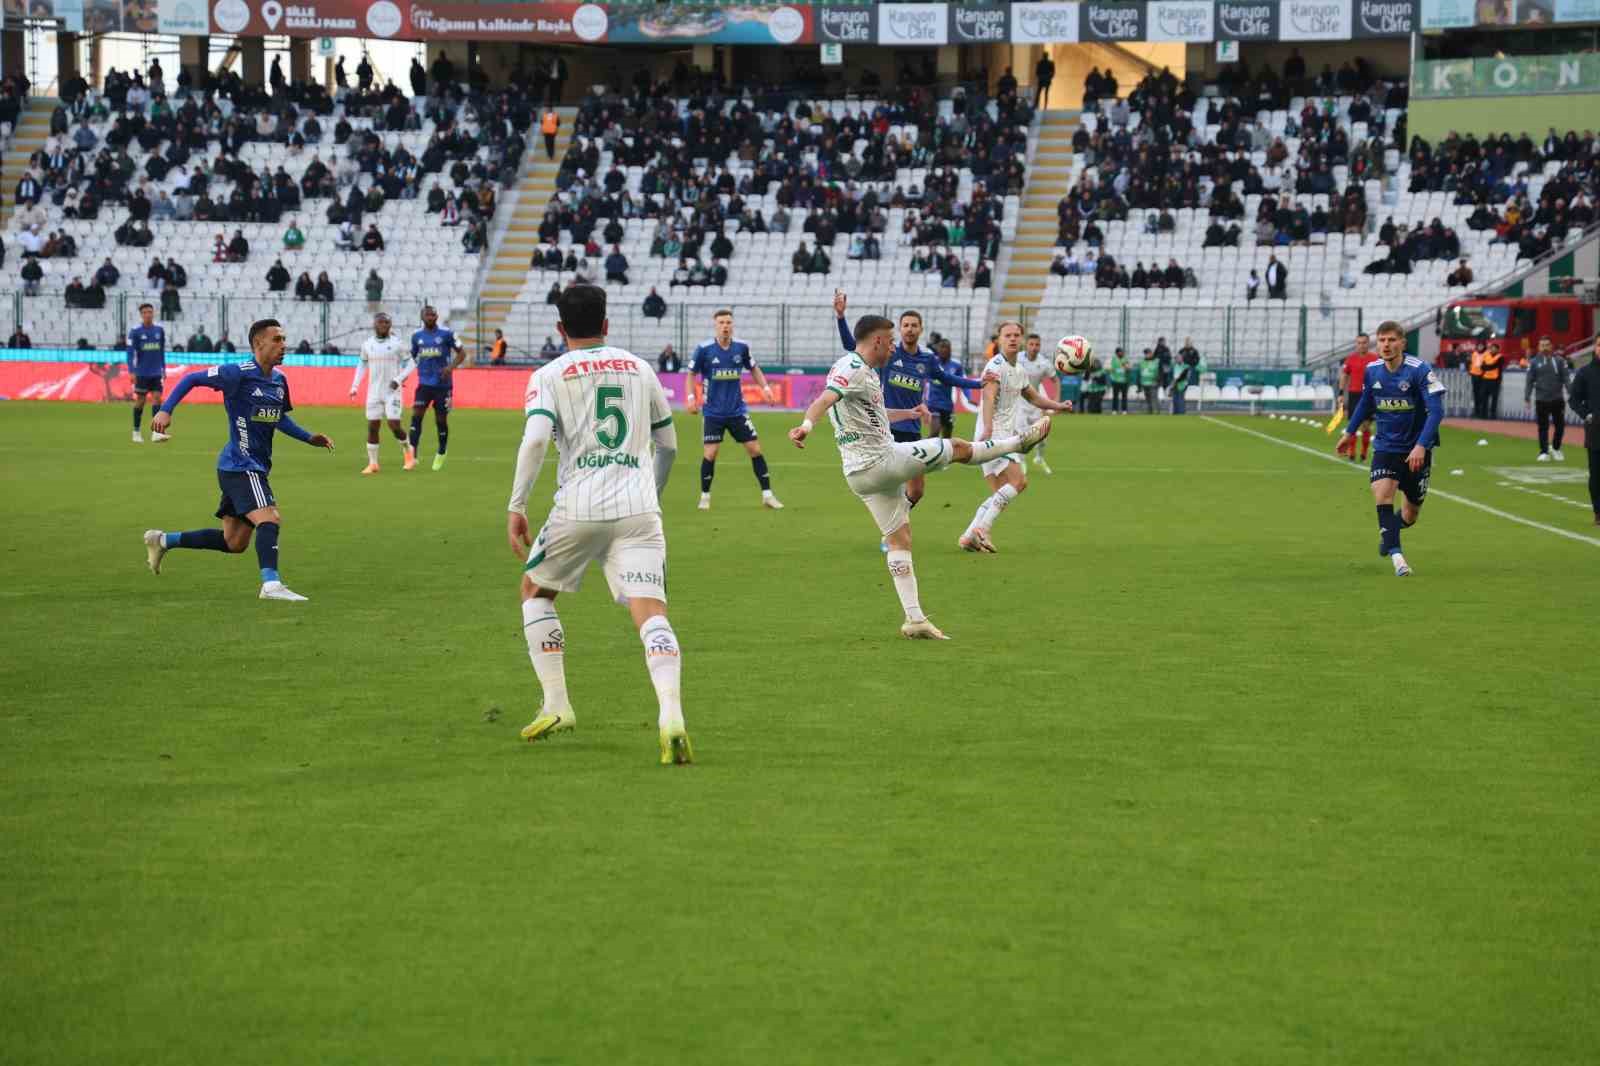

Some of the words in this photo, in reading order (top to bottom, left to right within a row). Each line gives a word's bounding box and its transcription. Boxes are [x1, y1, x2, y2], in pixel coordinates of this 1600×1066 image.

[821, 8, 869, 26] Kanyon
[888, 9, 936, 27] Kanyon
[956, 8, 1004, 26] Kanyon
[1089, 6, 1138, 24] Kanyon
[1220, 4, 1270, 22] Kanyon
[1361, 2, 1411, 19] Kanyon
[840, 21, 869, 39] Cafe
[321, 38, 333, 49] D
[826, 45, 836, 56] E
[1222, 41, 1231, 54] F
[562, 360, 639, 377] ATIKER
[596, 386, 628, 450] 5
